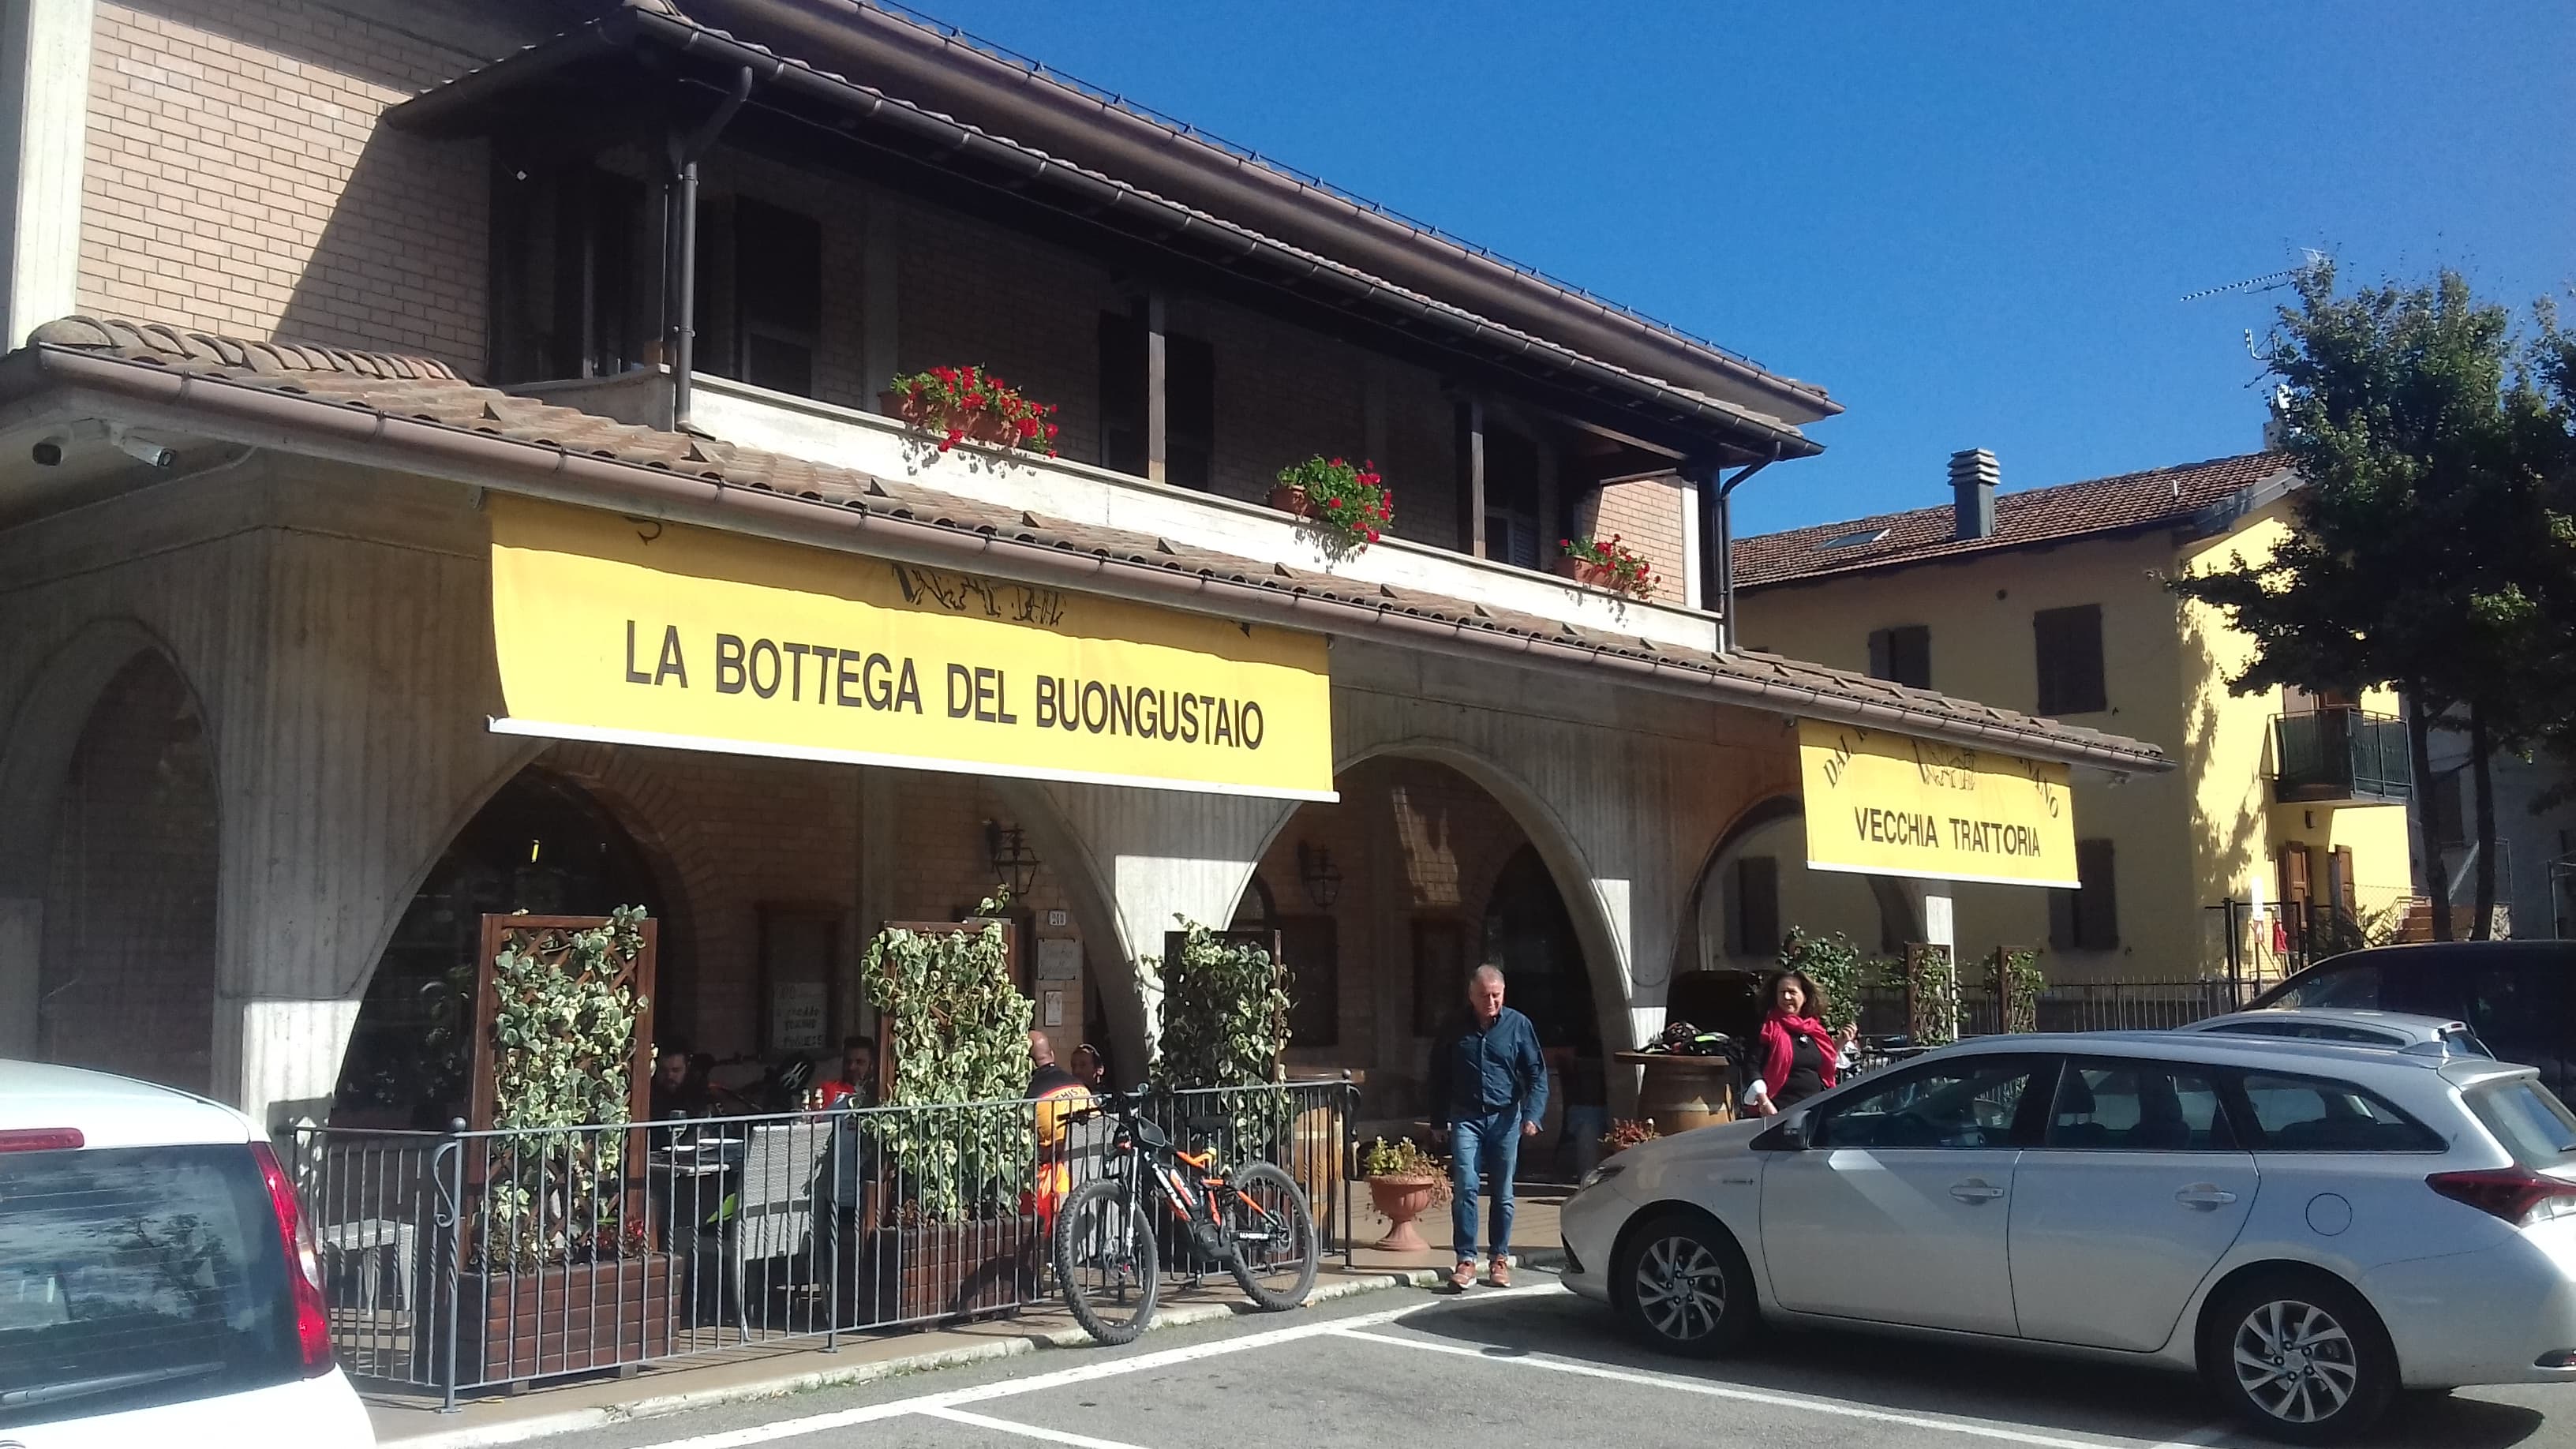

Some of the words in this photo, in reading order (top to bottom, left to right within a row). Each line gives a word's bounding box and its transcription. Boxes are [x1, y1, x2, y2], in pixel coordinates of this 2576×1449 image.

[625, 620, 689, 689] LA
[716, 632, 923, 715] BOTTEGA
[946, 662, 1017, 725] DEL
[1036, 674, 1264, 751] BUONGUSTAIO
[1854, 806, 1939, 848] VECCHIA
[1949, 818, 2041, 858] TRATTORIA
